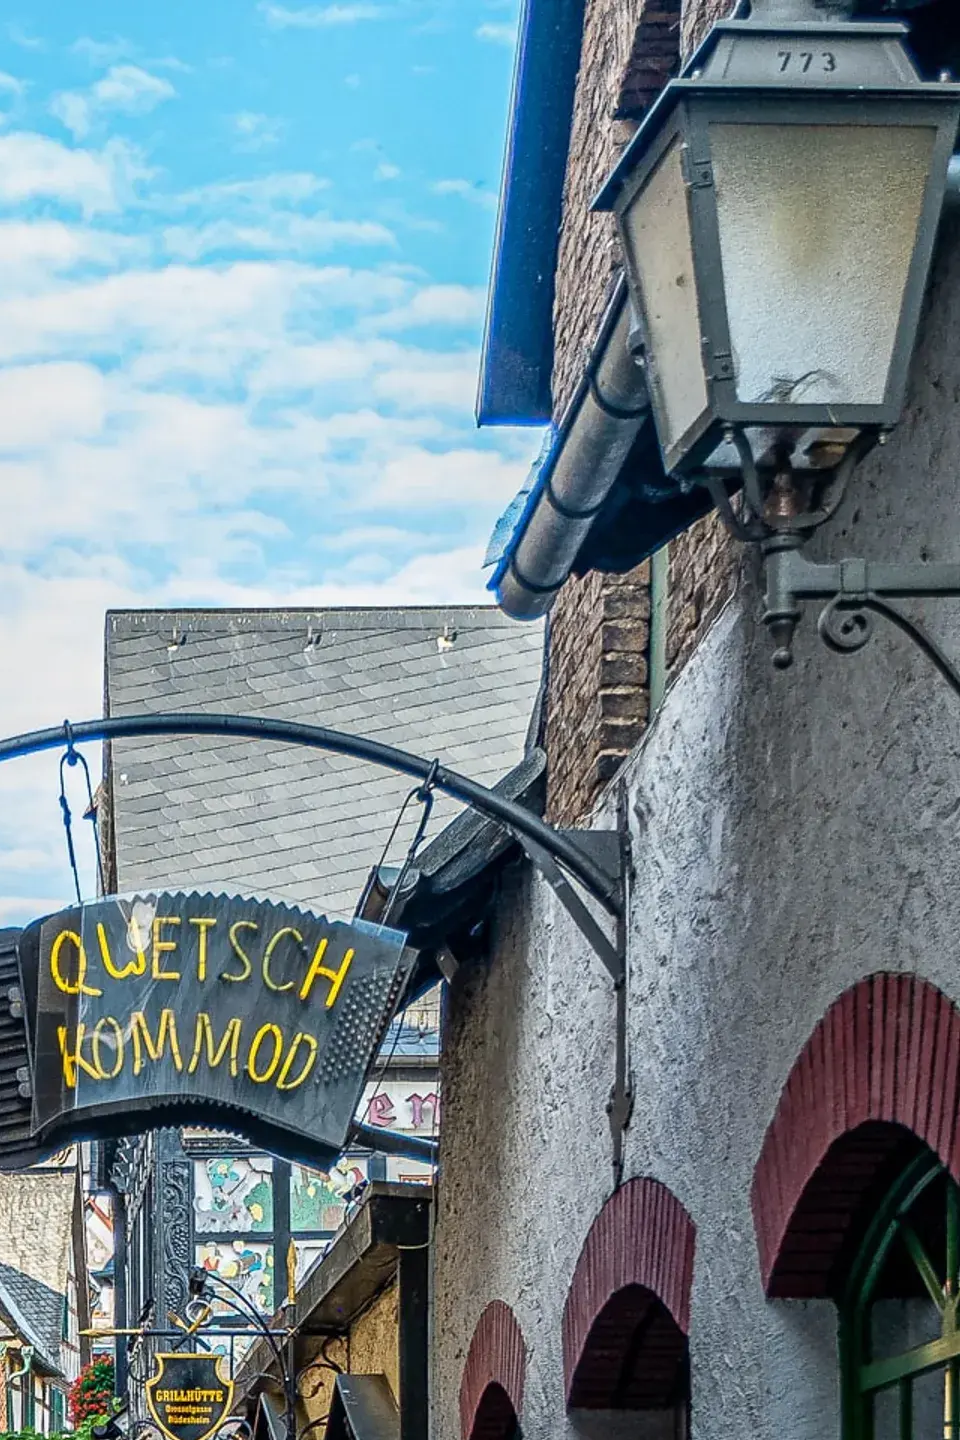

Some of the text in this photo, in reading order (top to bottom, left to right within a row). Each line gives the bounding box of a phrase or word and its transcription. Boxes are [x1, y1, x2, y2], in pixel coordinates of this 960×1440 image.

[777, 52, 837, 73] 773
[49, 915, 355, 1009] QUETSCH
[57, 1008, 320, 1091] KOMMOD
[155, 1387, 224, 1403] GRILLHÜTTE
